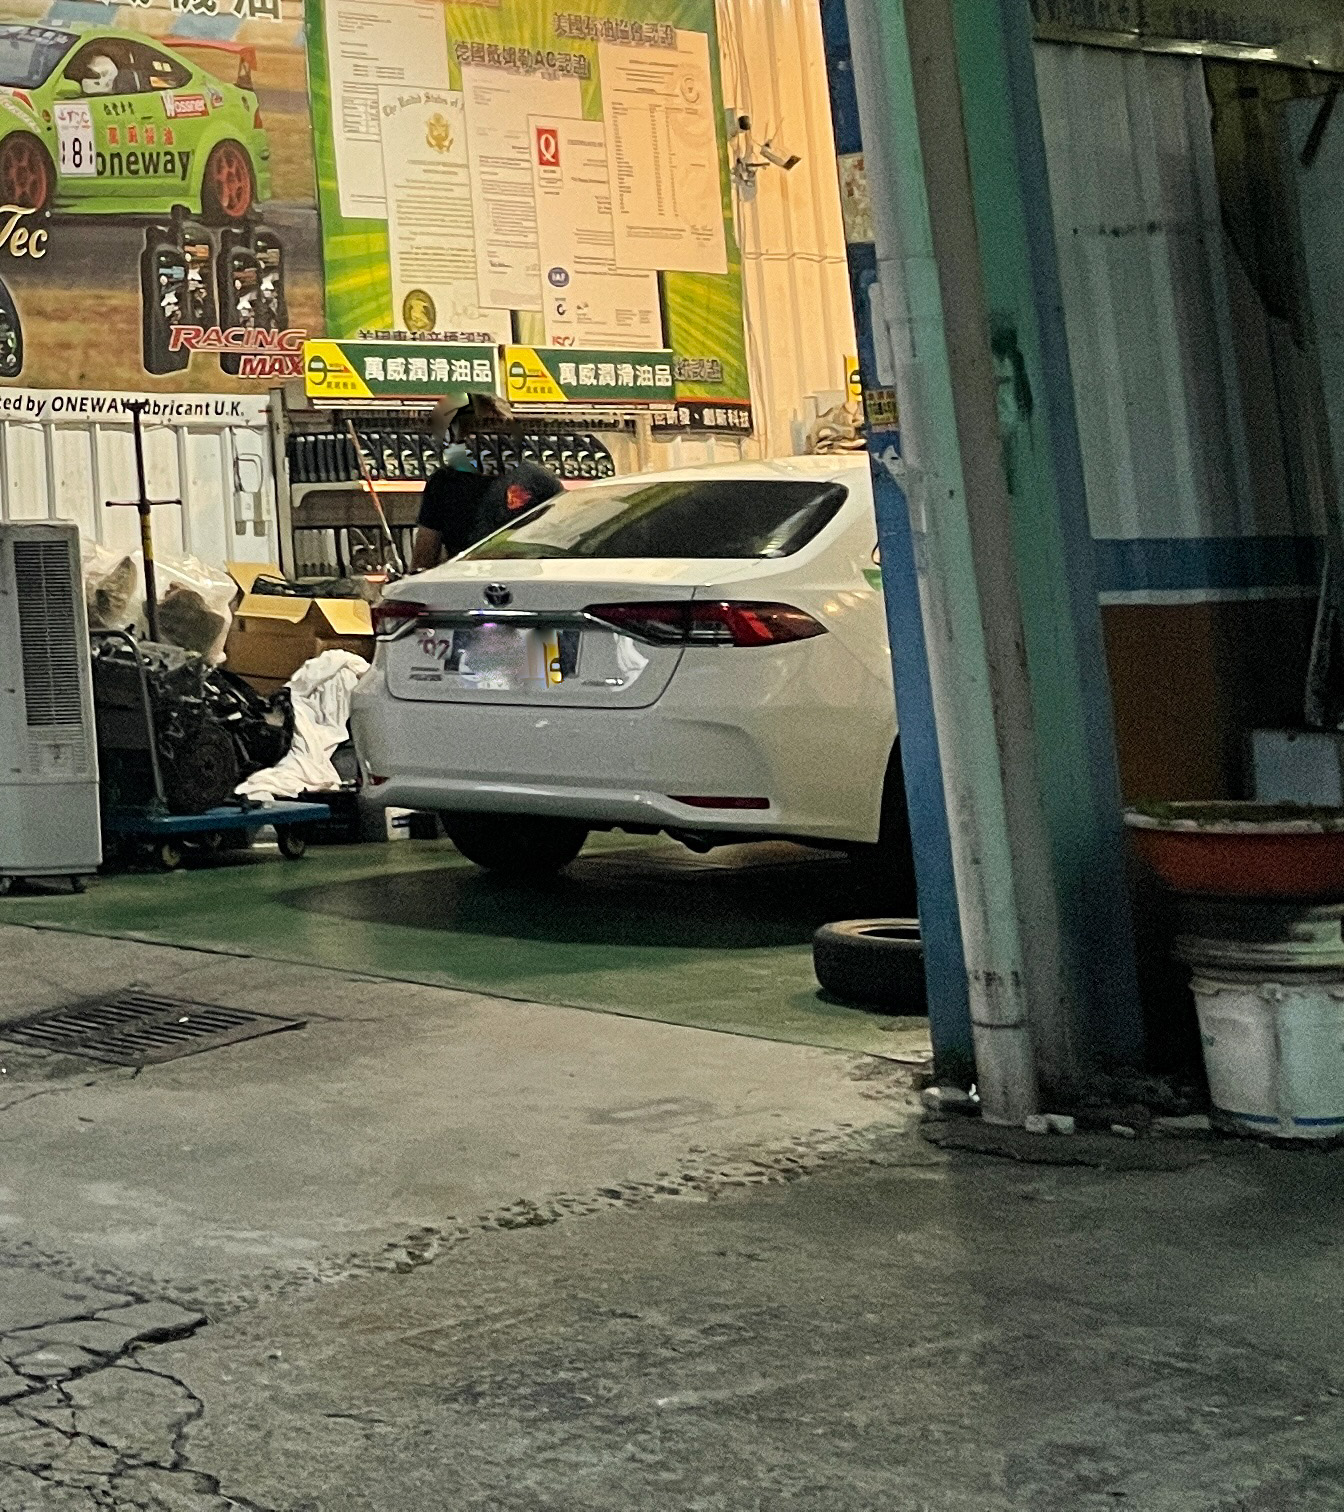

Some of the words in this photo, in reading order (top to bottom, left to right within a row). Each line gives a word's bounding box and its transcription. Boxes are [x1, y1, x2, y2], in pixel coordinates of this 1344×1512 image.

[96, 150, 192, 181] oneway
[168, 324, 308, 353] RACING
[238, 353, 305, 380] MAX
[363, 356, 493, 383] 萬威潤滑油品
[558, 362, 673, 387] 萬威潤滑油品
[26, 395, 47, 416] by
[51, 396, 128, 414] ONEWAY
[132, 397, 210, 416] ubricant
[214, 401, 245, 418] U.K.
